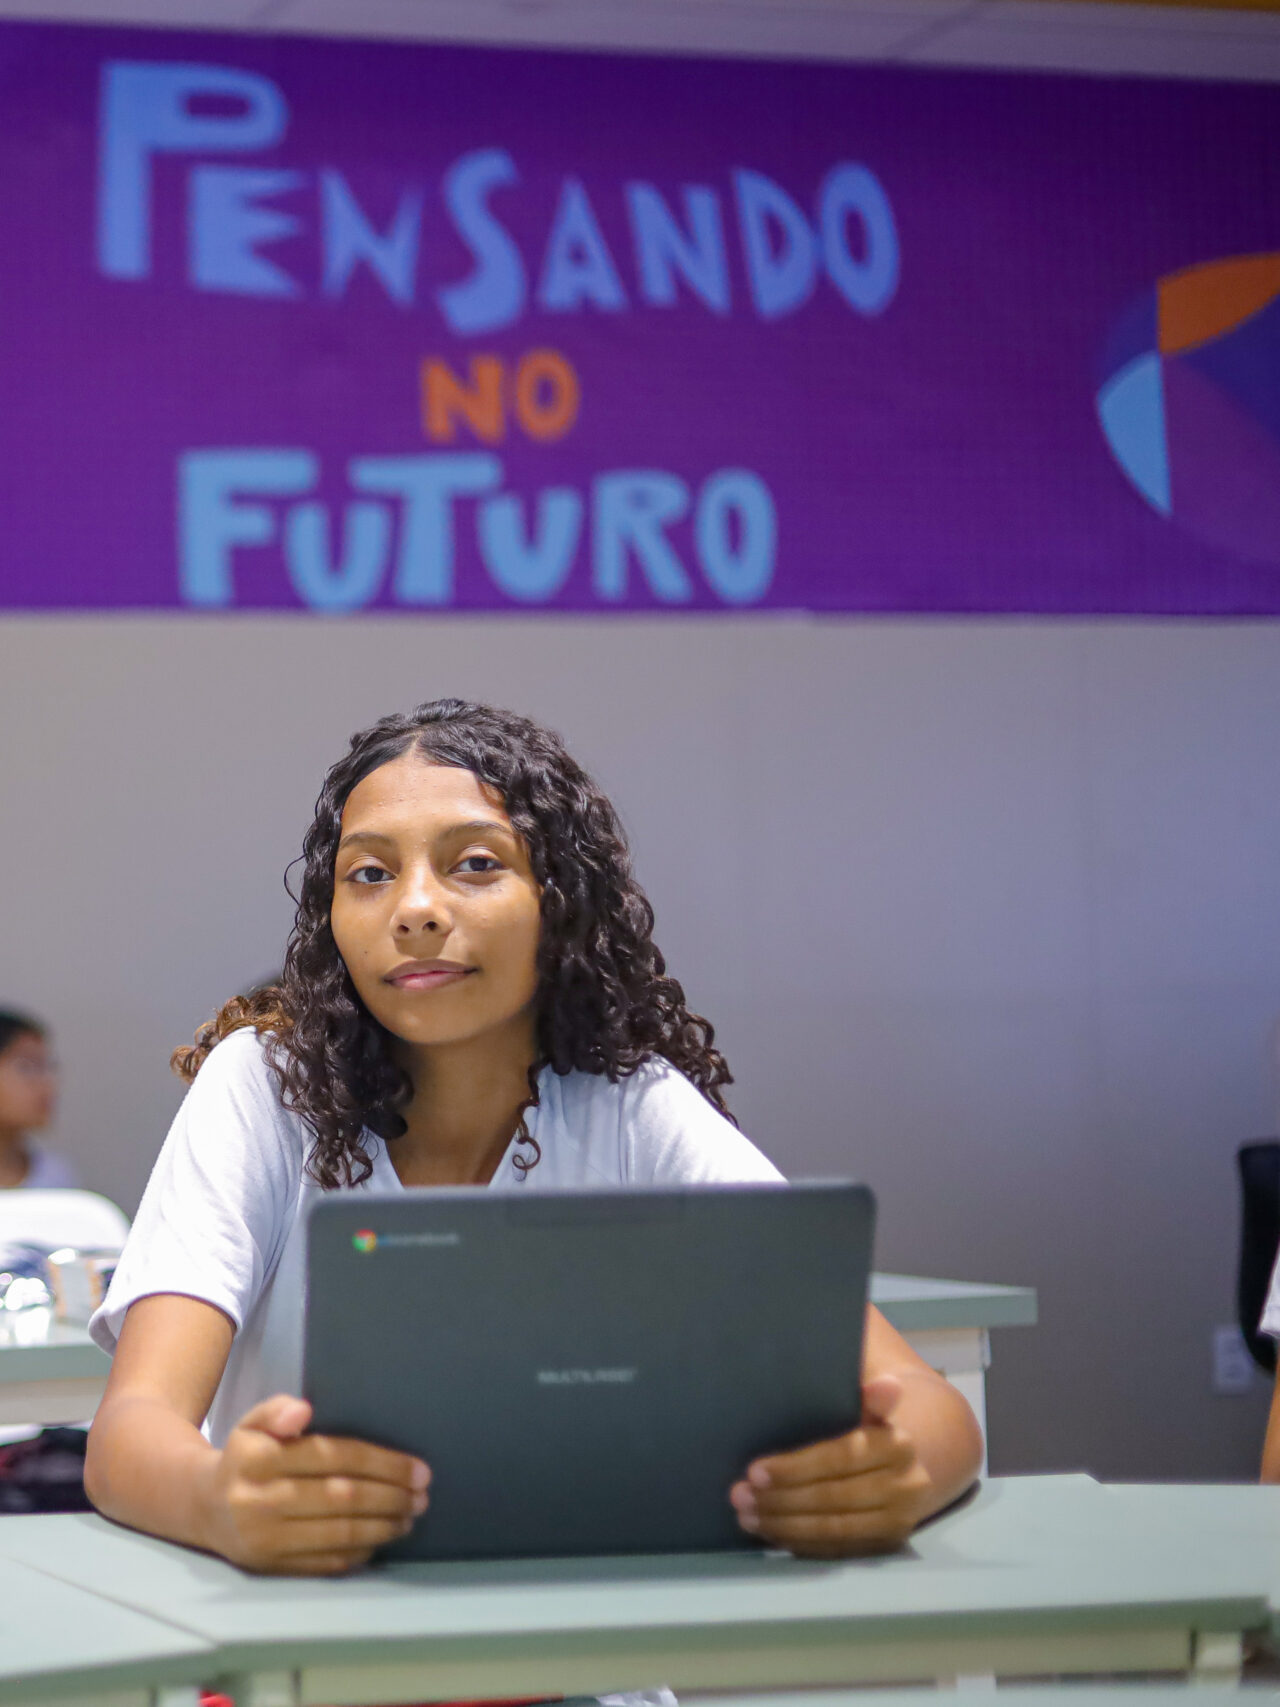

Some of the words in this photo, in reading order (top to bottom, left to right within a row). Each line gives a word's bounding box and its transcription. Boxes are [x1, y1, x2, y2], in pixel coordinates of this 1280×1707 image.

[96, 61, 899, 334] PENSANDO
[420, 348, 580, 443] NO
[177, 448, 777, 613] FUTURO
